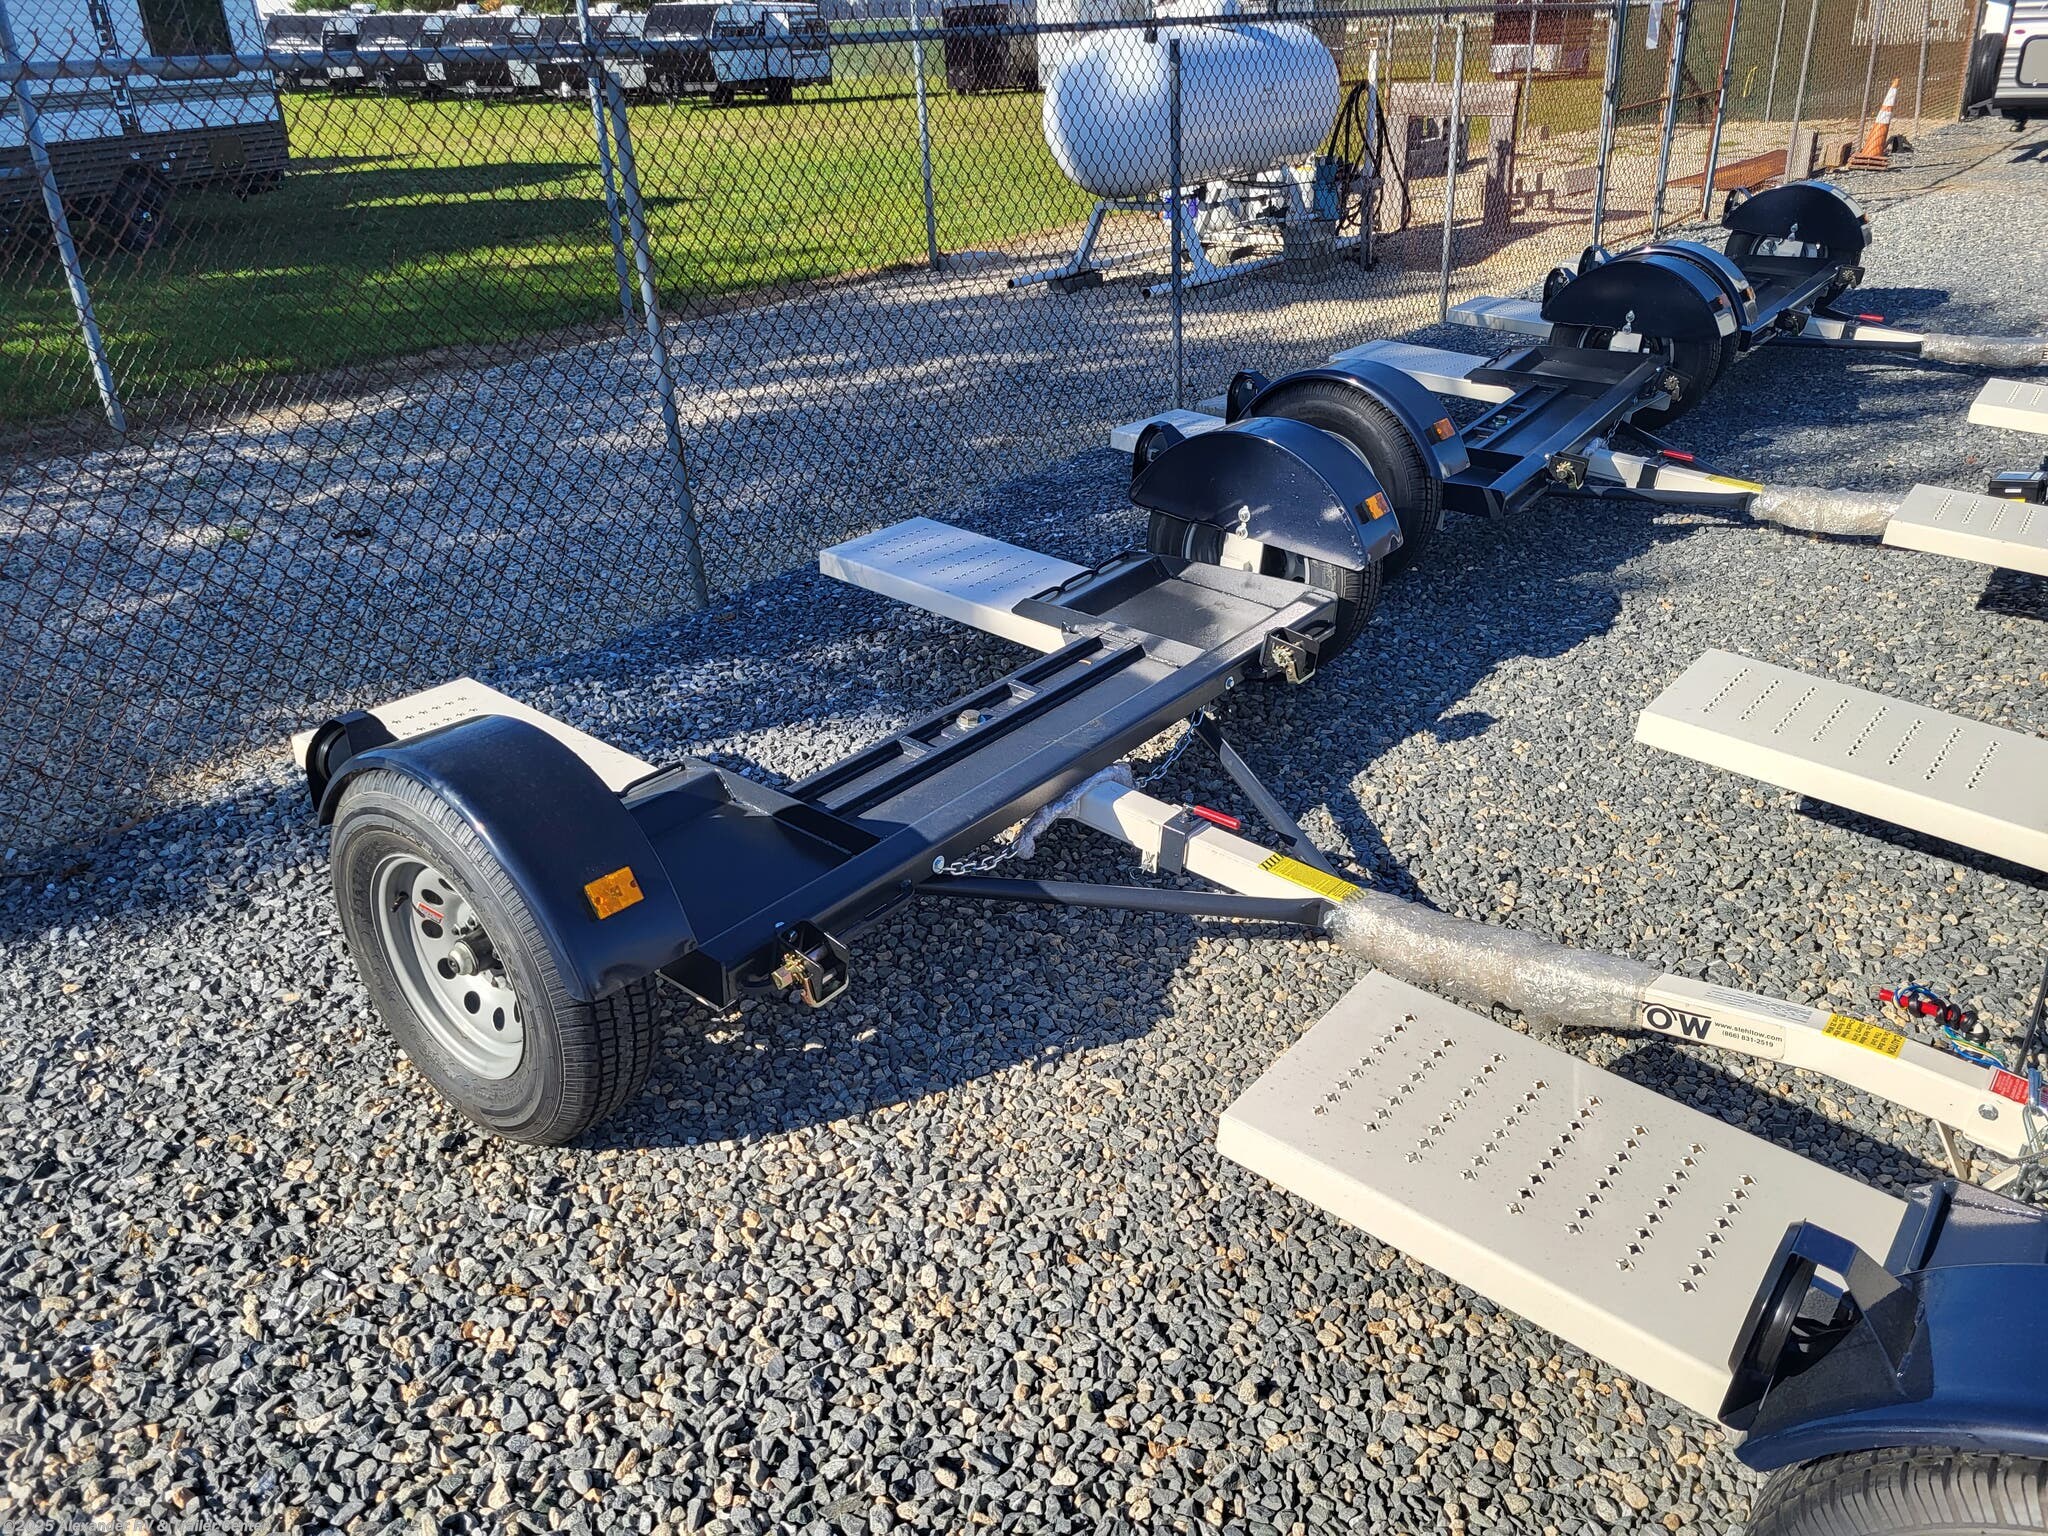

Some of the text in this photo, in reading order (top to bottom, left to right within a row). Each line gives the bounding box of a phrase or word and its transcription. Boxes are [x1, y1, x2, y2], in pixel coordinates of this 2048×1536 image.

[1714, 1021, 1783, 1042] www.stehltow.com
[1721, 1030, 1774, 1047] (866) 831-2519
